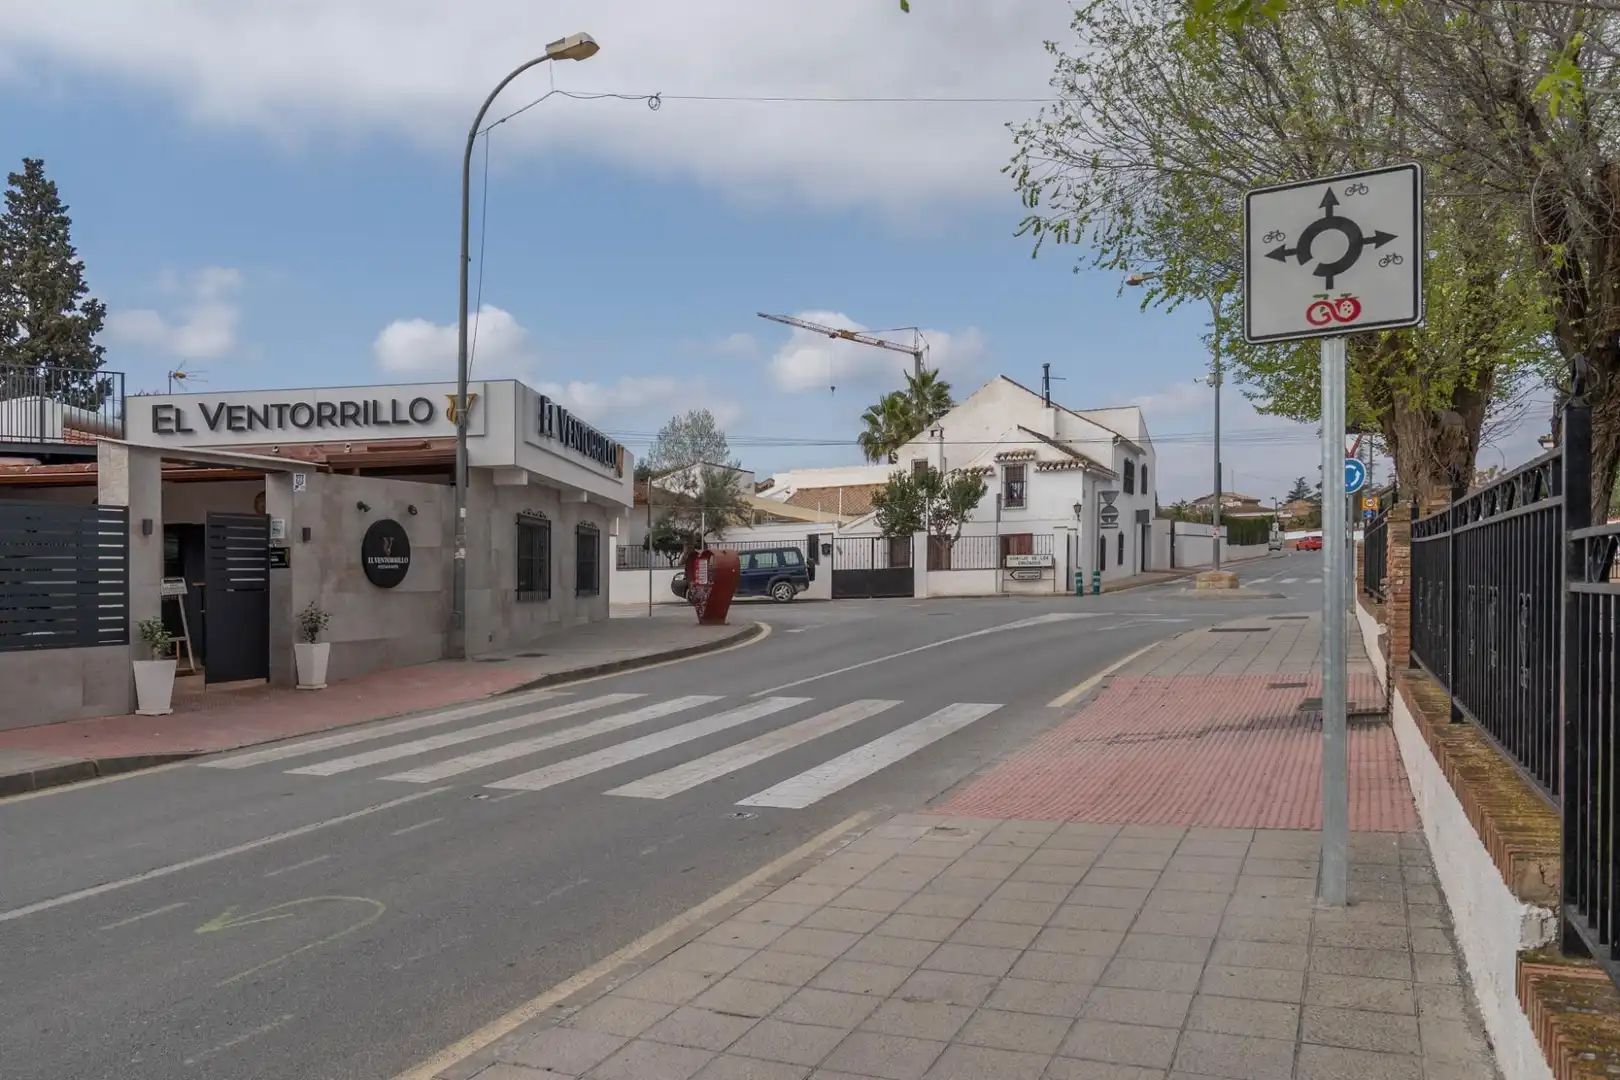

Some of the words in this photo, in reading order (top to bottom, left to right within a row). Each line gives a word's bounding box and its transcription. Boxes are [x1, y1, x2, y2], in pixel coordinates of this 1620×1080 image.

[151, 404, 194, 434] EL
[198, 396, 435, 432] VENTORRILLO
[538, 394, 556, 440] EL
